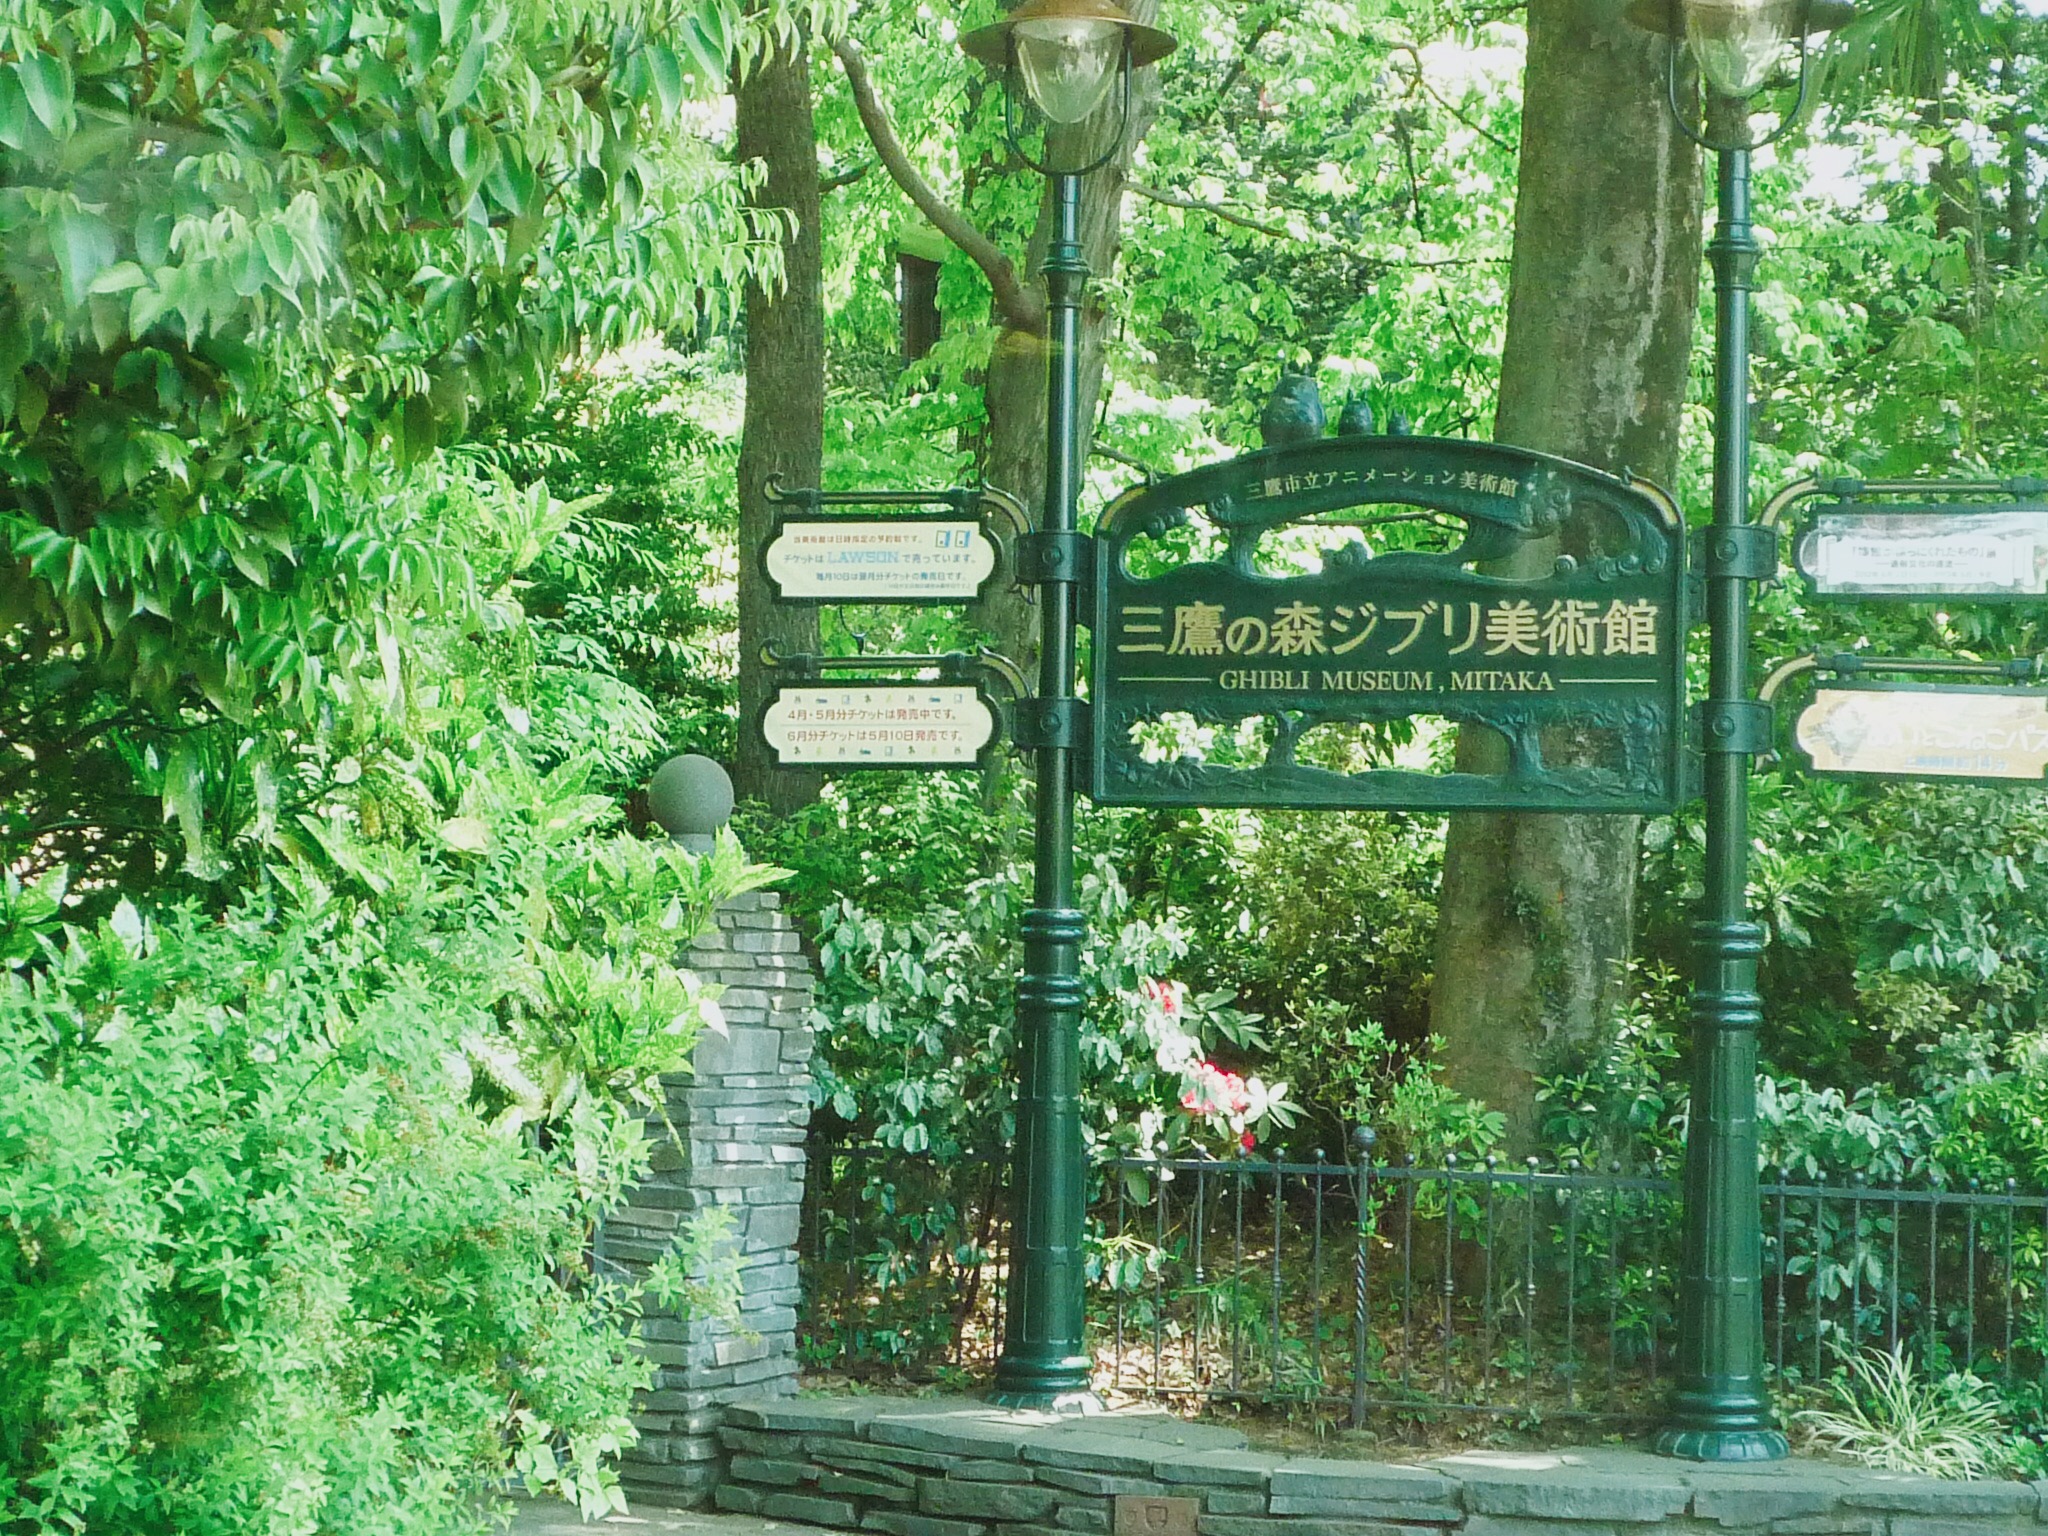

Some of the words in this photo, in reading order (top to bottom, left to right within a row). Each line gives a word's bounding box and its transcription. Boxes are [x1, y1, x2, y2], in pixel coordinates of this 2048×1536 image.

[1244, 468, 1519, 500] 三鷹市立アニメーション美術館
[783, 554, 825, 565] チケットは
[827, 551, 900, 564] LAWSON
[902, 554, 977, 564] で売っています。
[1117, 598, 1658, 657] 三鷹の森ジブリ美術館
[1219, 671, 1310, 691] GHIBLI
[1450, 671, 1555, 692] MITAKA
[787, 730, 963, 742] 6月分チケットは5月10日発売です。
